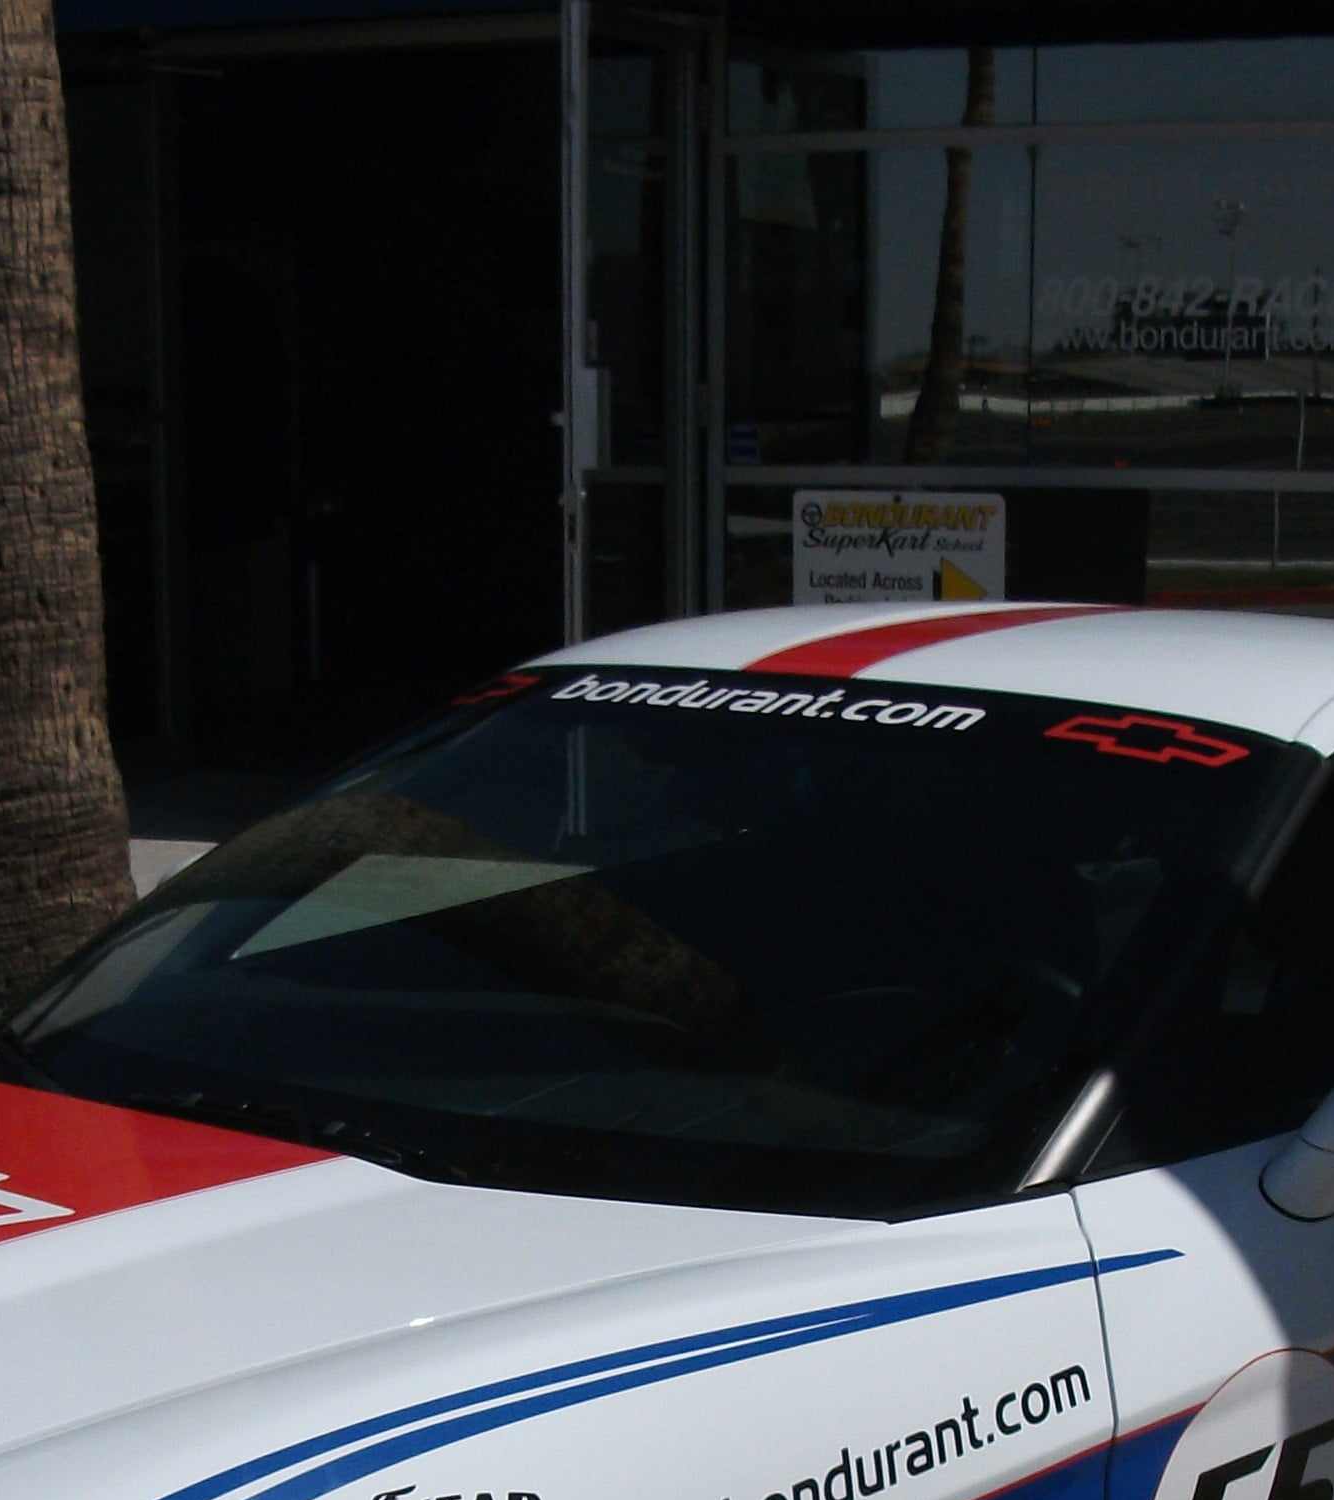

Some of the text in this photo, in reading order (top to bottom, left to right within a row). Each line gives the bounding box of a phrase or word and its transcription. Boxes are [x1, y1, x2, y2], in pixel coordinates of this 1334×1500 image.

[823, 503, 995, 531] BONDURANT
[934, 537, 983, 553] School
[810, 570, 923, 592] Located Across
[552, 674, 986, 732] bondurant.com
